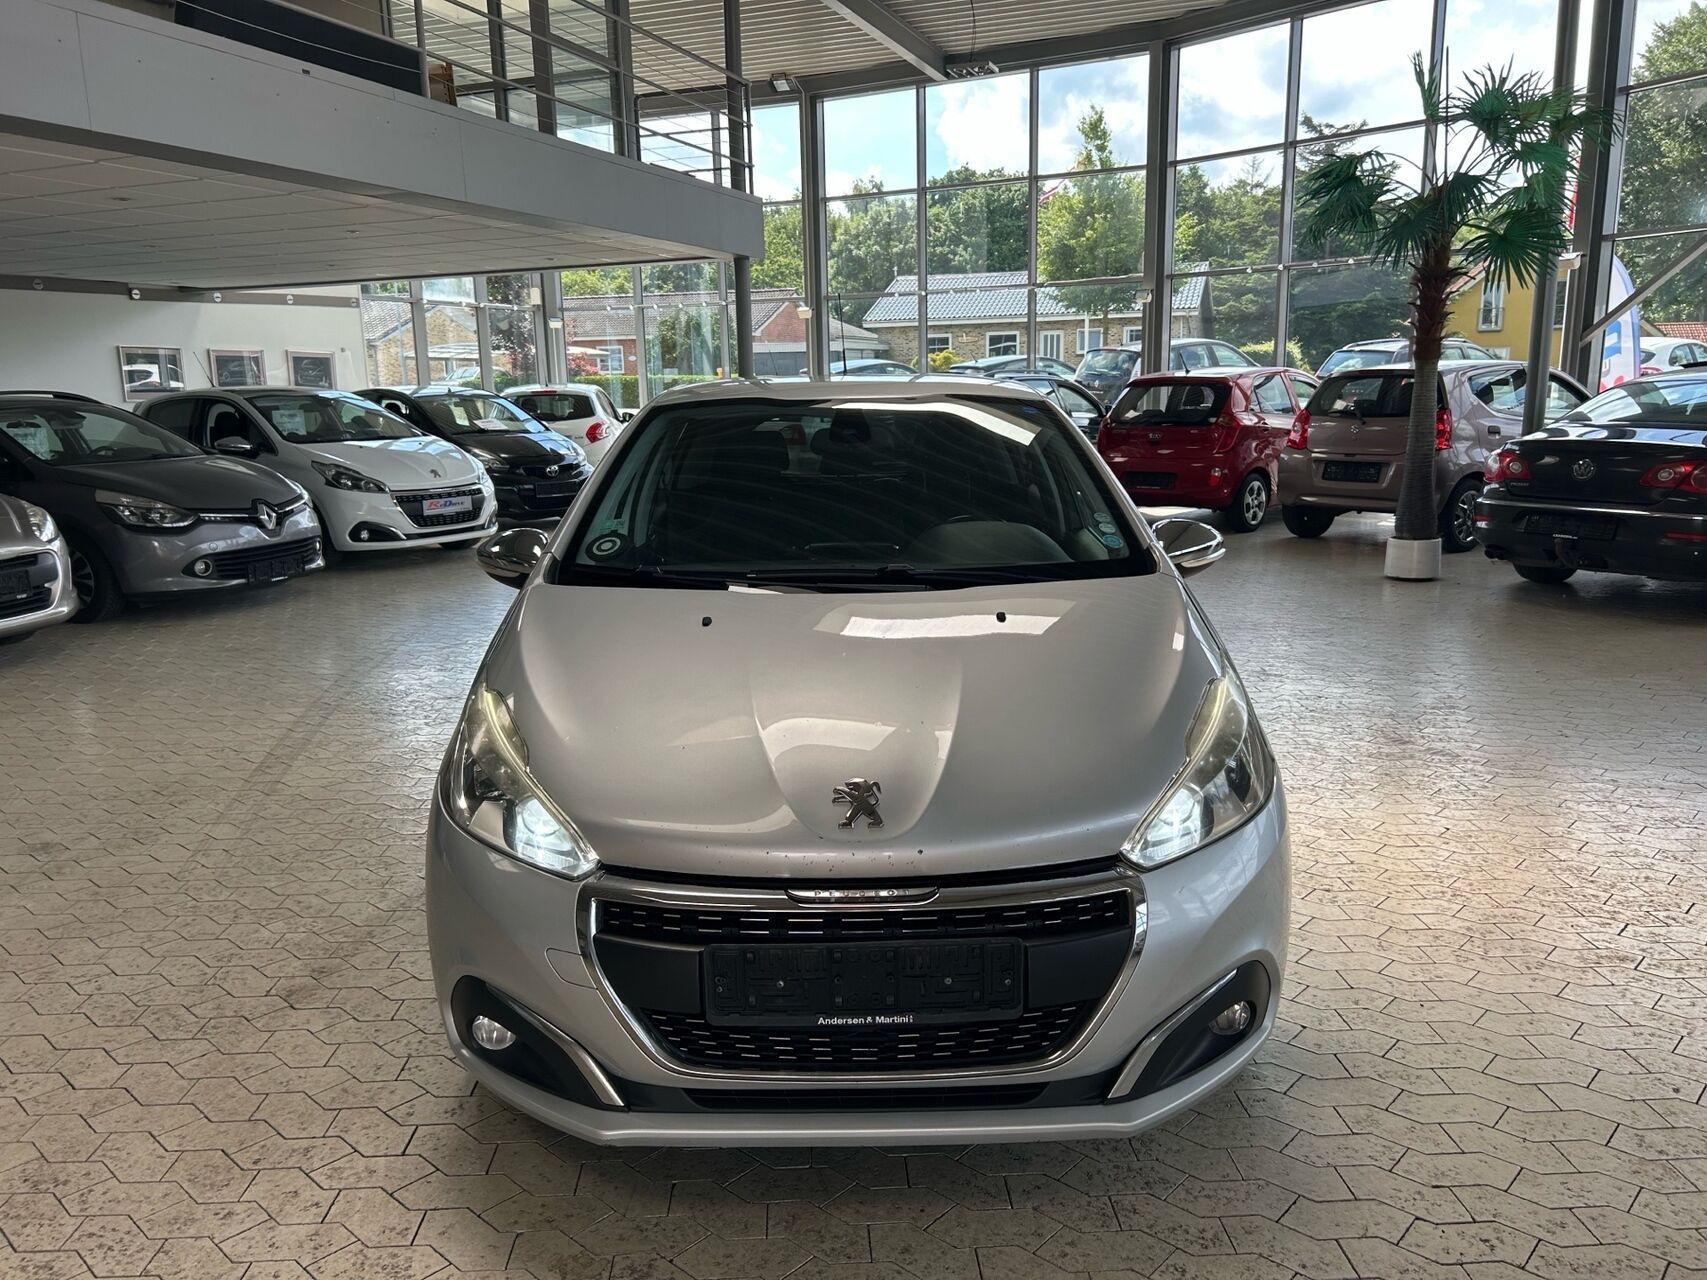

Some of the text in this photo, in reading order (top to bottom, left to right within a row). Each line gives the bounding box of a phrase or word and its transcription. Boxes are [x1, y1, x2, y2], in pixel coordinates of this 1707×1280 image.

[817, 1016, 865, 1025] Andersen
[866, 1016, 873, 1024] &
[875, 1015, 909, 1024] Martini
